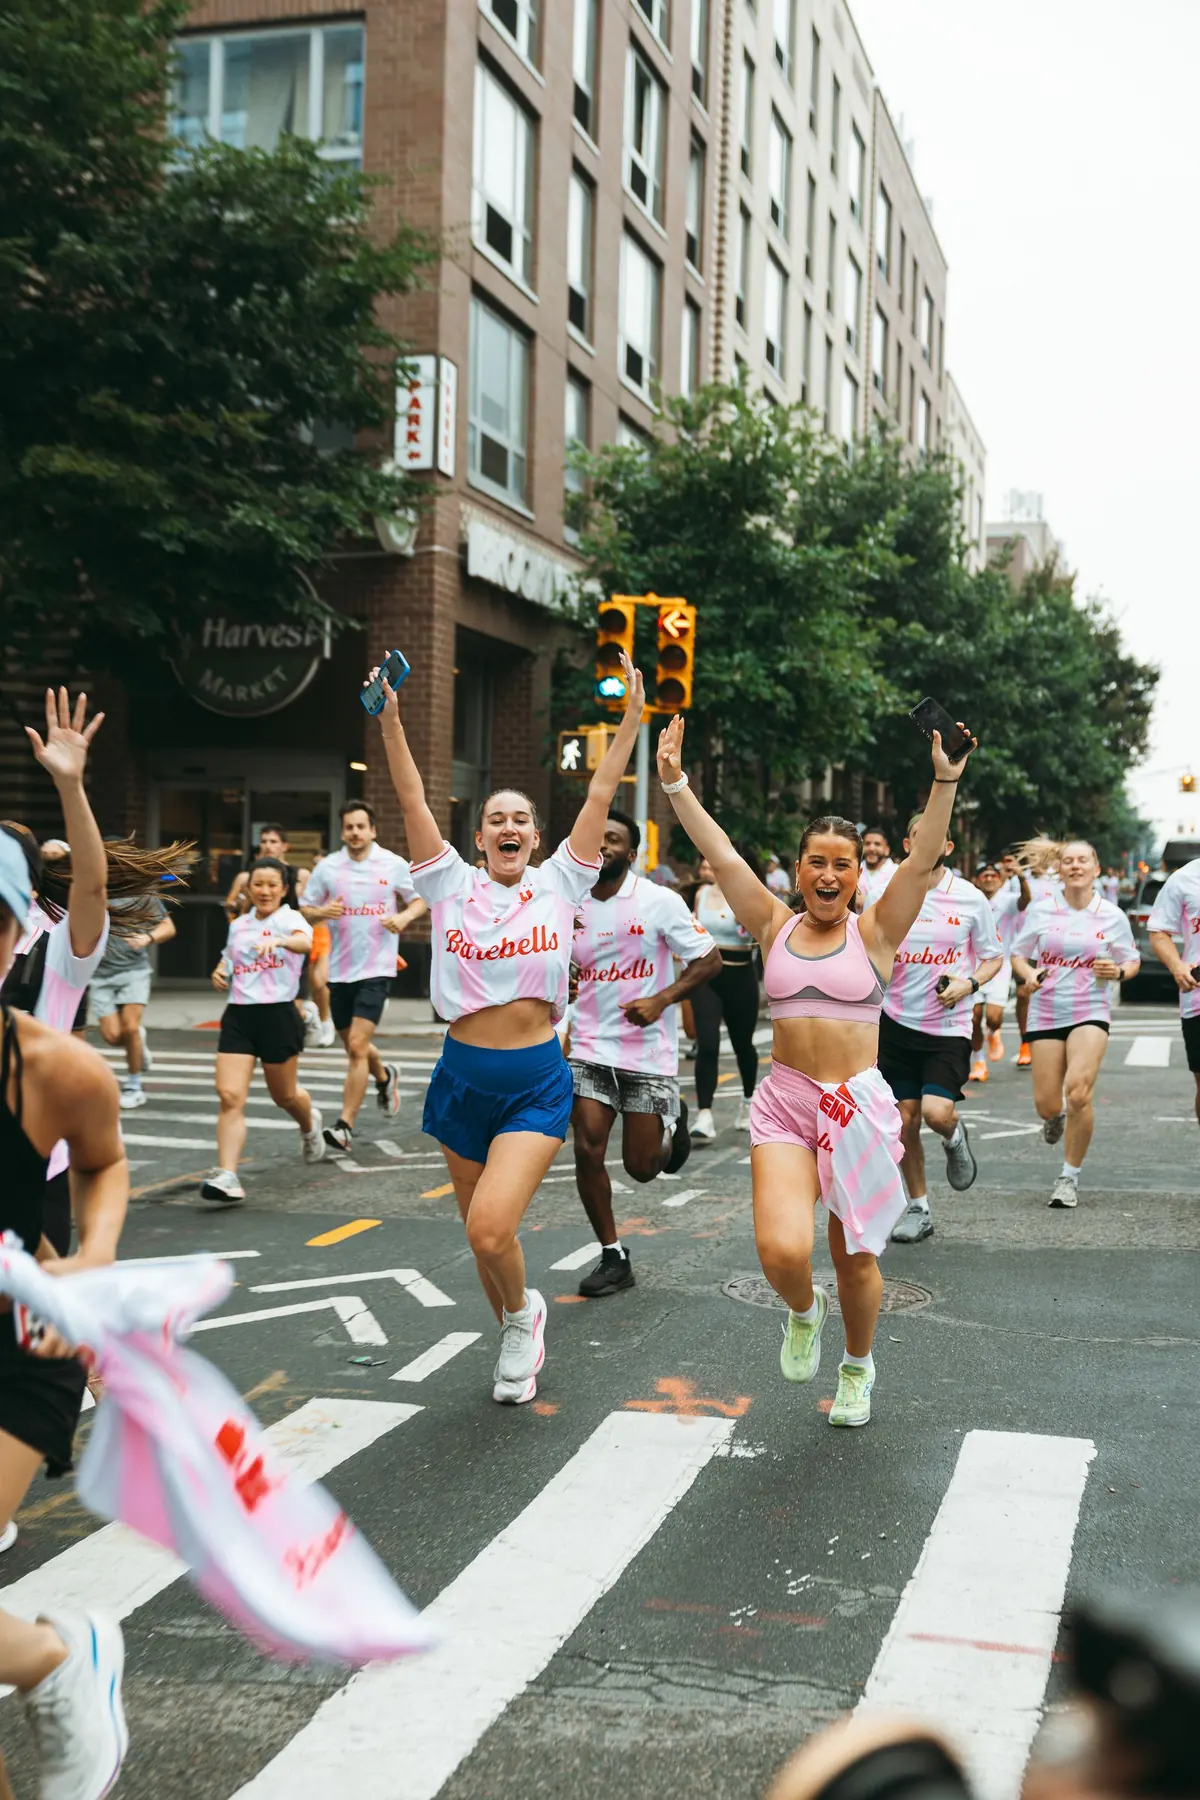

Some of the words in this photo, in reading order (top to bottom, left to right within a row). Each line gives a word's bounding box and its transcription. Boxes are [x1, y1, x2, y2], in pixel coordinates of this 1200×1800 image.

[407, 380, 421, 443] PARK
[198, 665, 288, 701] MARKET
[445, 925, 559, 961] Barebells
[577, 959, 654, 982] arebells
